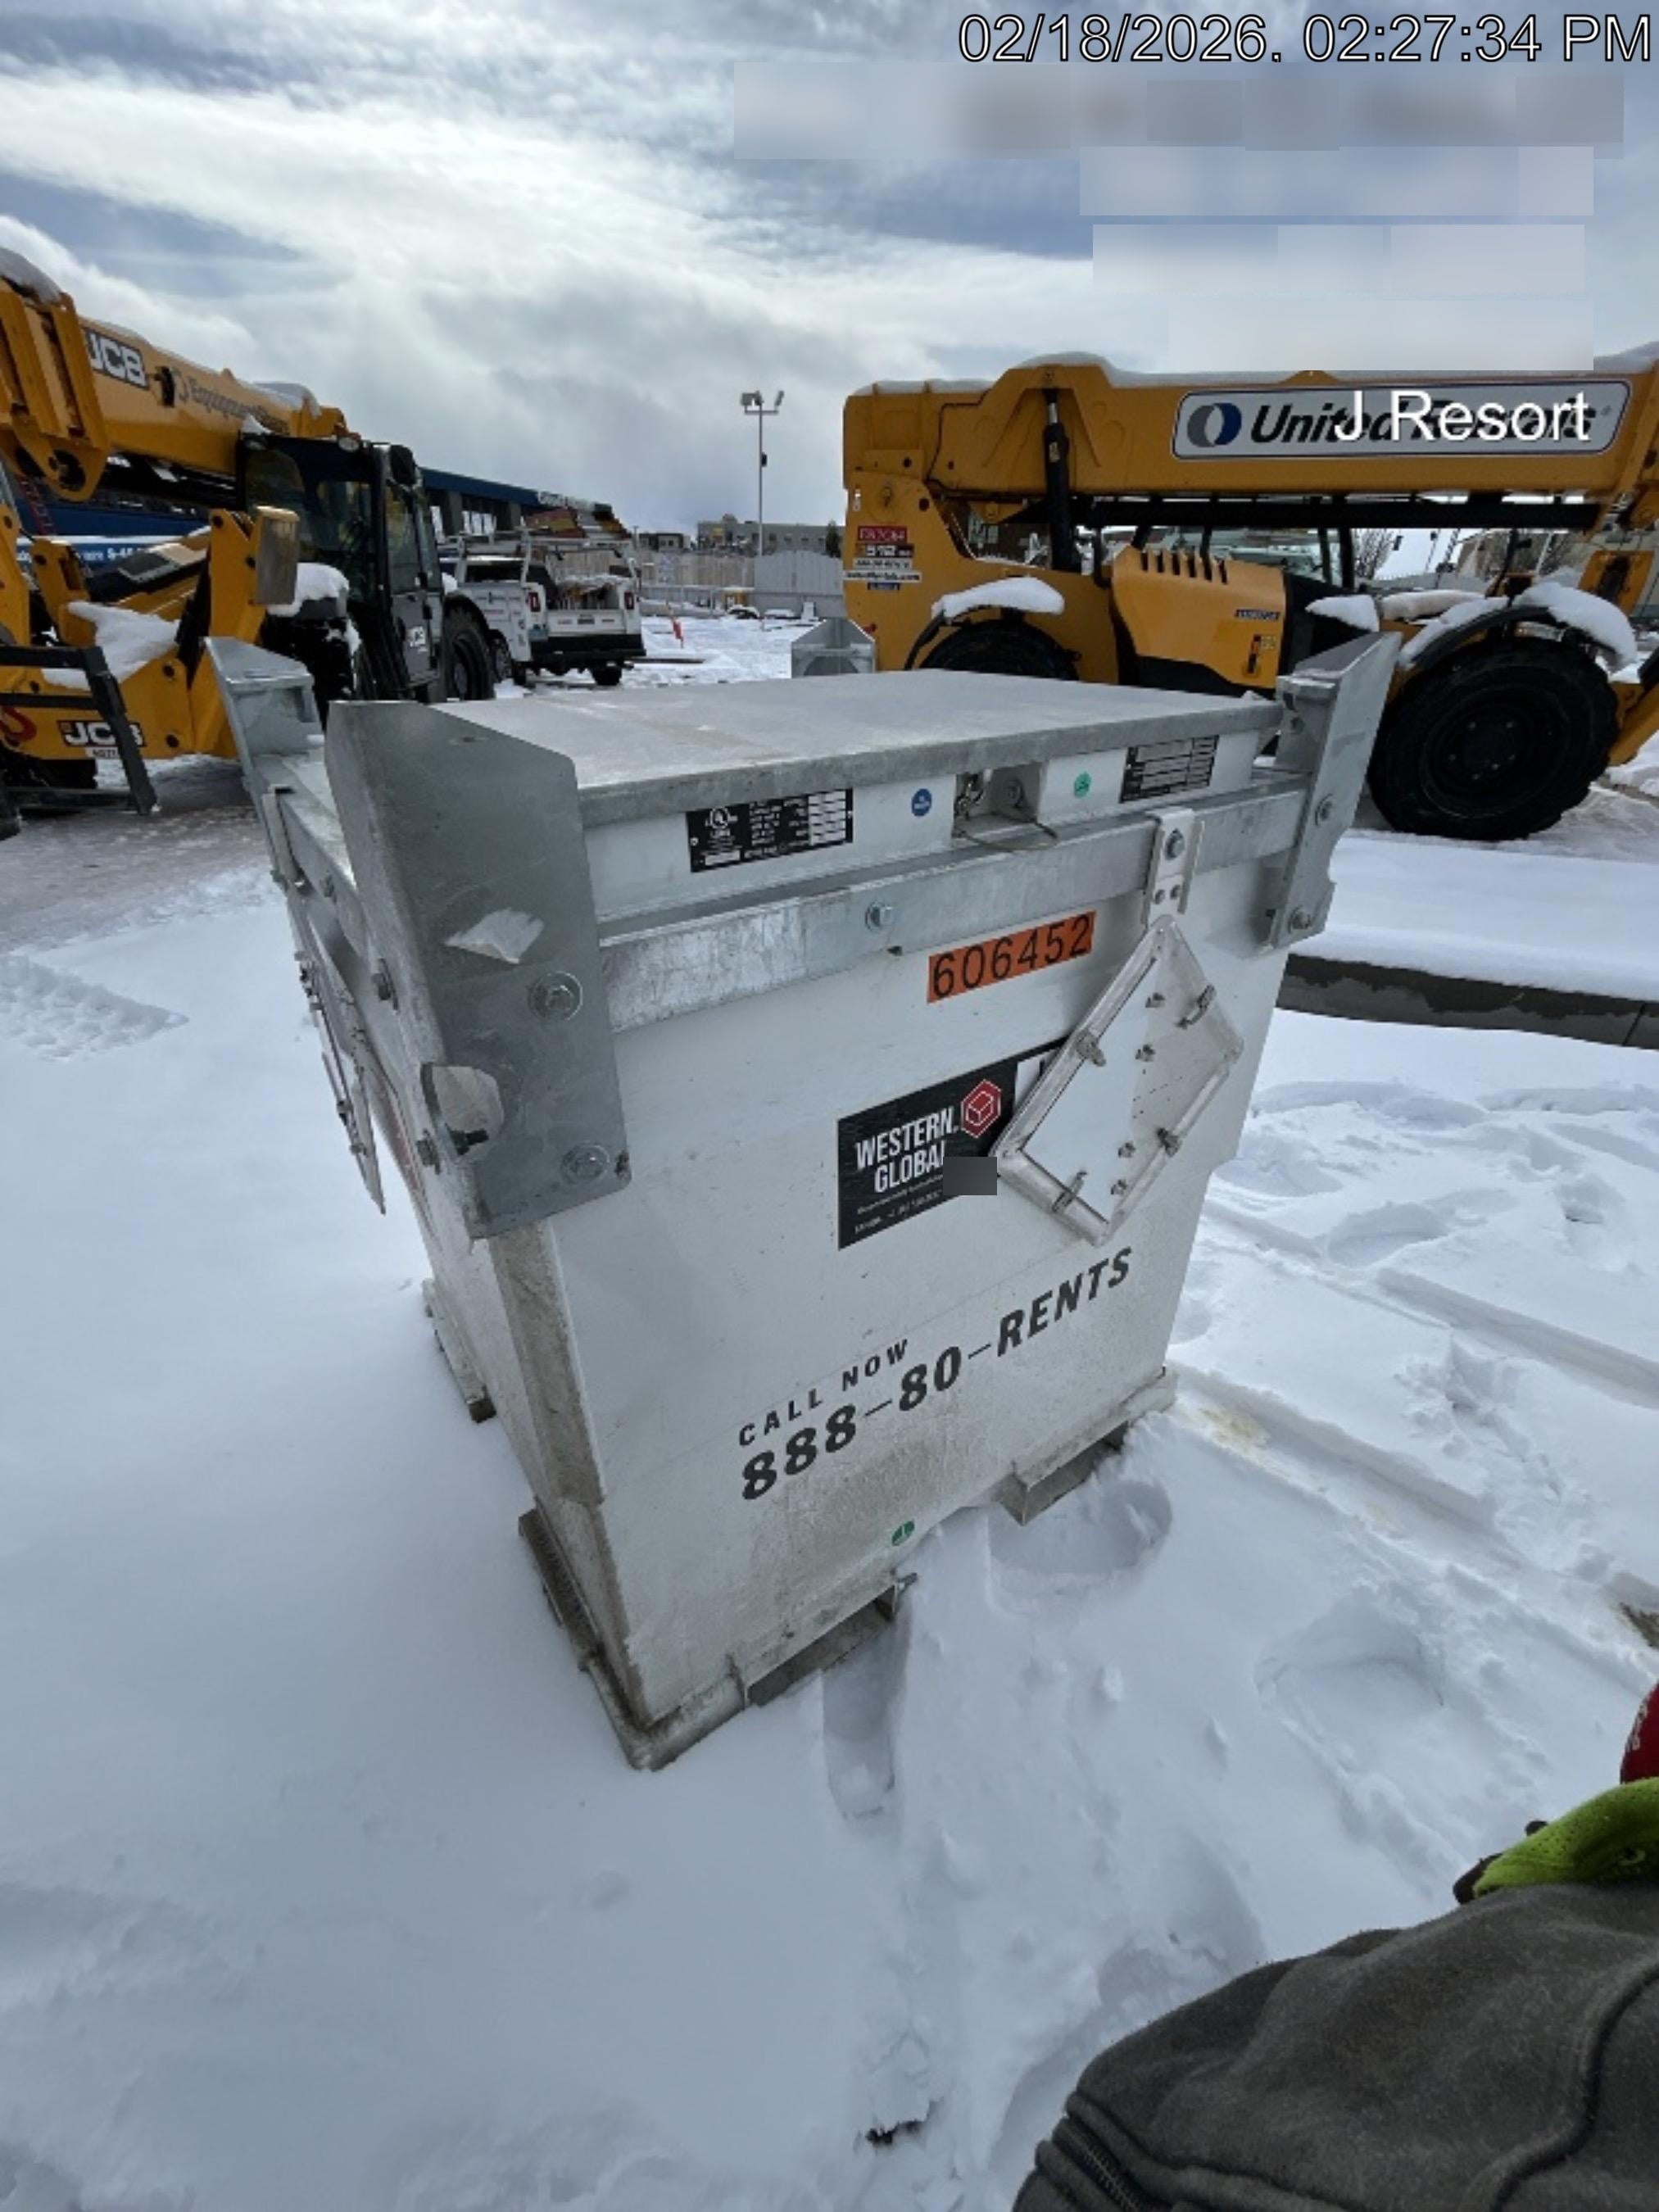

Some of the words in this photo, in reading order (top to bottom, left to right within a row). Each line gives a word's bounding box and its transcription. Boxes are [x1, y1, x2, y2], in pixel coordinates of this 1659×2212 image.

[88, 333, 148, 388] JCB
[933, 913, 1090, 999] 606452
[854, 1105, 954, 1170] WESTERN
[738, 1388, 823, 1448] CALL
[841, 1338, 909, 1391] NOW
[741, 1246, 1132, 1501] 888-80-RENTS
